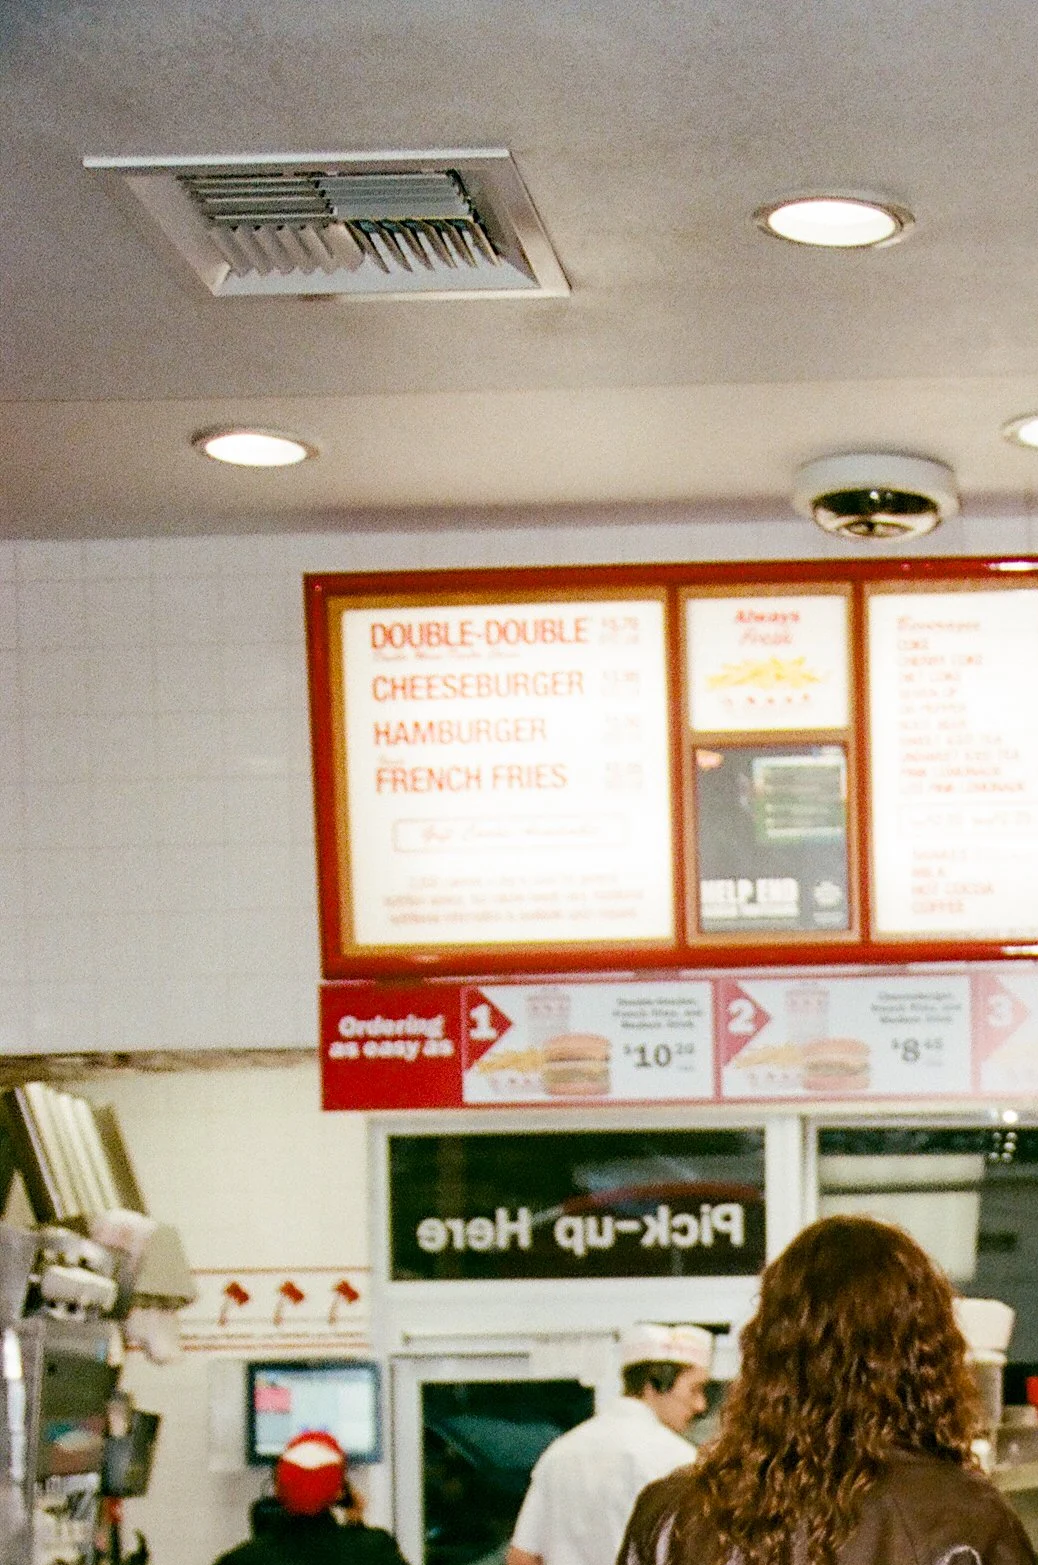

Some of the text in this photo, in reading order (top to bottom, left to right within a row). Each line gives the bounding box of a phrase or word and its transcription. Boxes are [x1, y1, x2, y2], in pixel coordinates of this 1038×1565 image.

[370, 617, 589, 650] DOUBLE-DOUBLE
[371, 671, 585, 702] CHEESEBURGER
[373, 717, 547, 747] HAMBURGER
[375, 763, 568, 795] FRENCH FRIES
[338, 1014, 446, 1039] Ordering
[469, 1003, 498, 1039] 1
[727, 1000, 756, 1034] 2
[328, 1039, 455, 1062] as easy as
